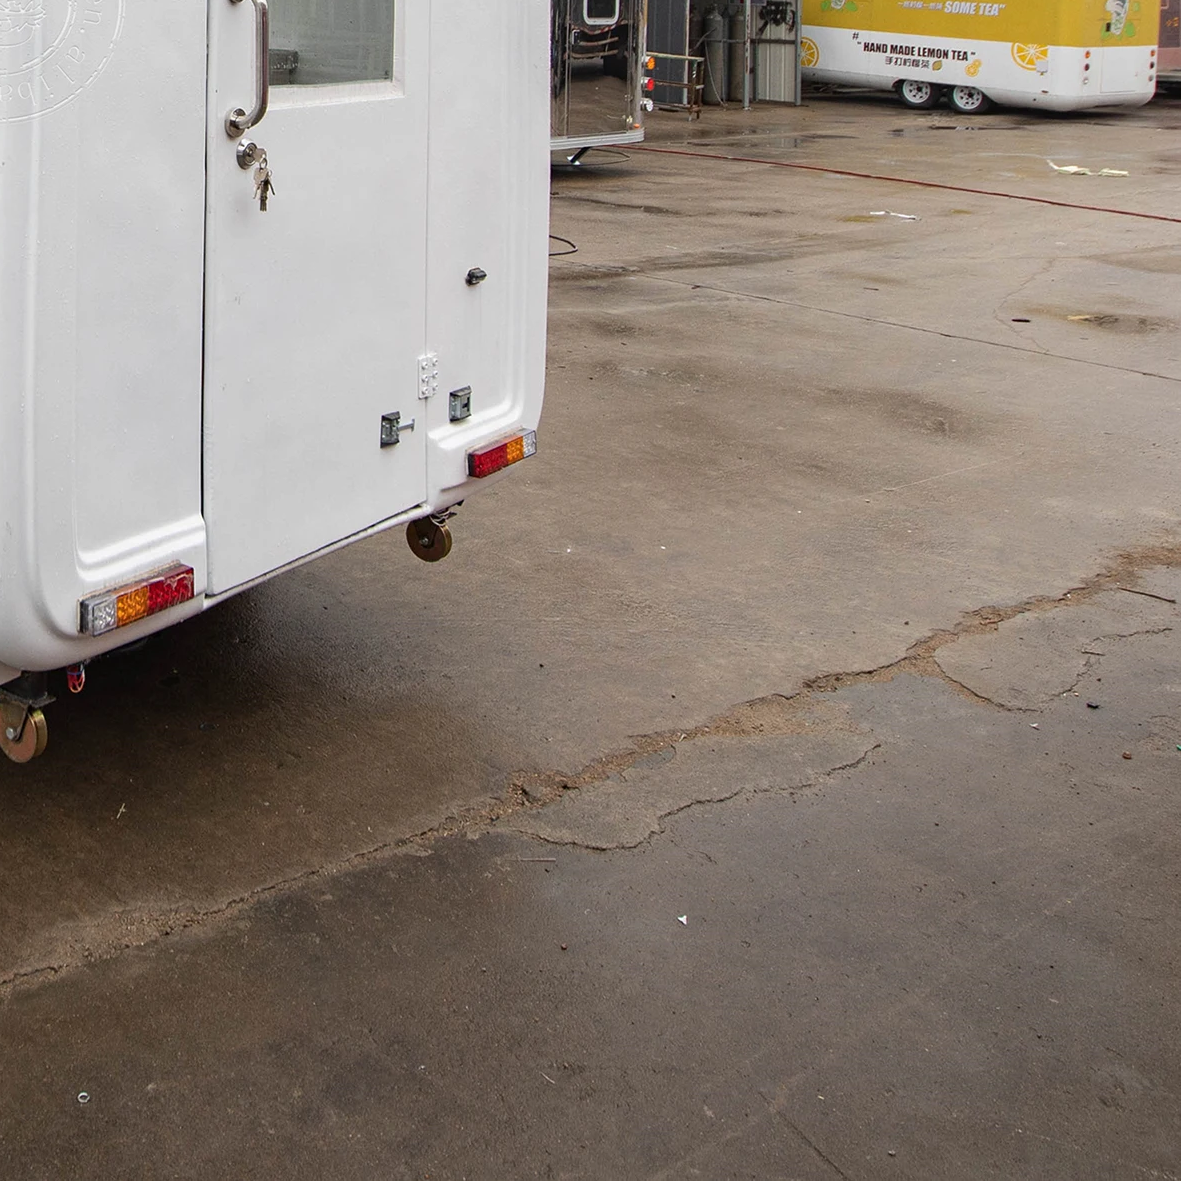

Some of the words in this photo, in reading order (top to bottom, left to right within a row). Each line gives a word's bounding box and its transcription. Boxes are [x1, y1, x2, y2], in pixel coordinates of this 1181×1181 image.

[944, 1, 976, 14] SOME
[863, 42, 888, 54] HAND
[890, 44, 916, 56] MADE
[917, 46, 949, 59] LEMON
[951, 49, 968, 61] TEA
